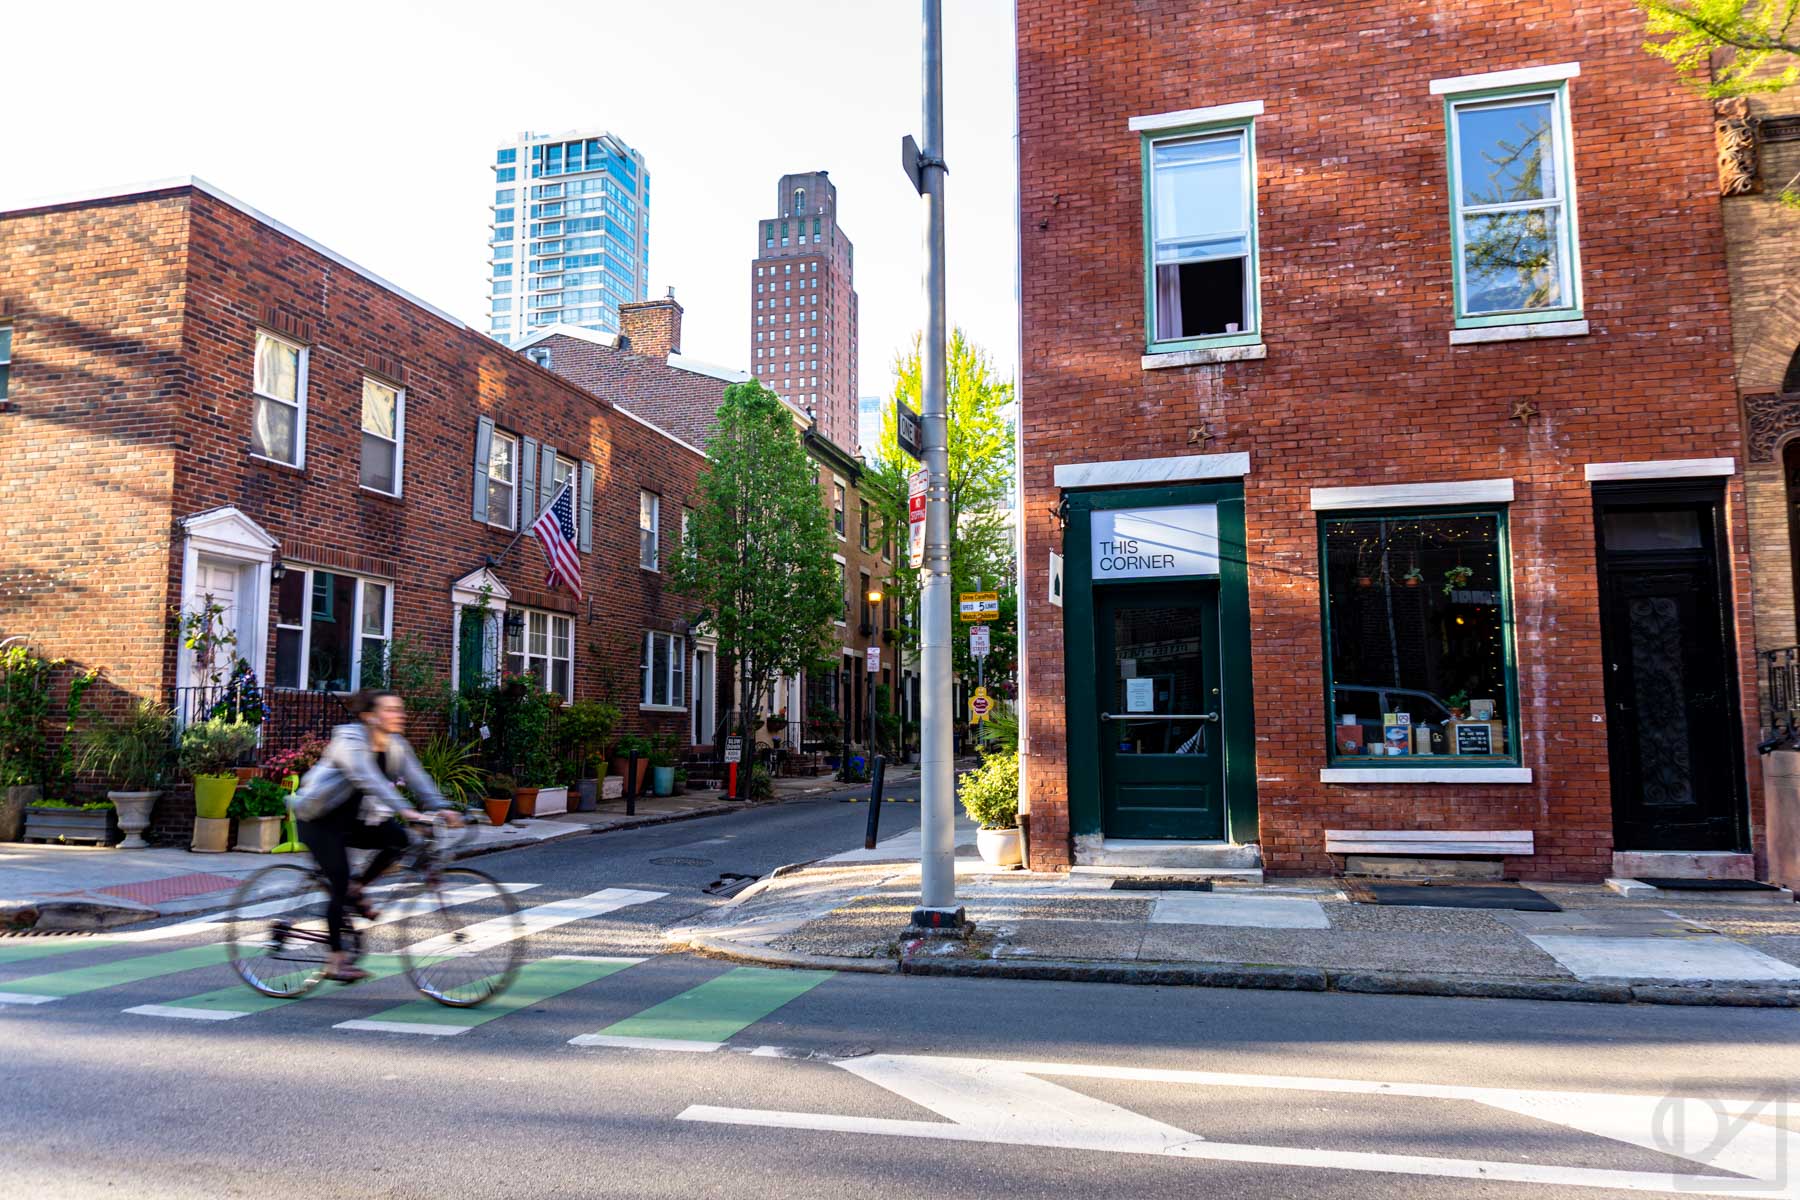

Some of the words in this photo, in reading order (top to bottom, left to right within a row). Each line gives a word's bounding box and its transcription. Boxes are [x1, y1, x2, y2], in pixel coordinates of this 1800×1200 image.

[902, 418, 913, 441] ONE
[1100, 540, 1138, 555] THIS
[1100, 554, 1175, 571] CORNER
[979, 602, 985, 611] 5
